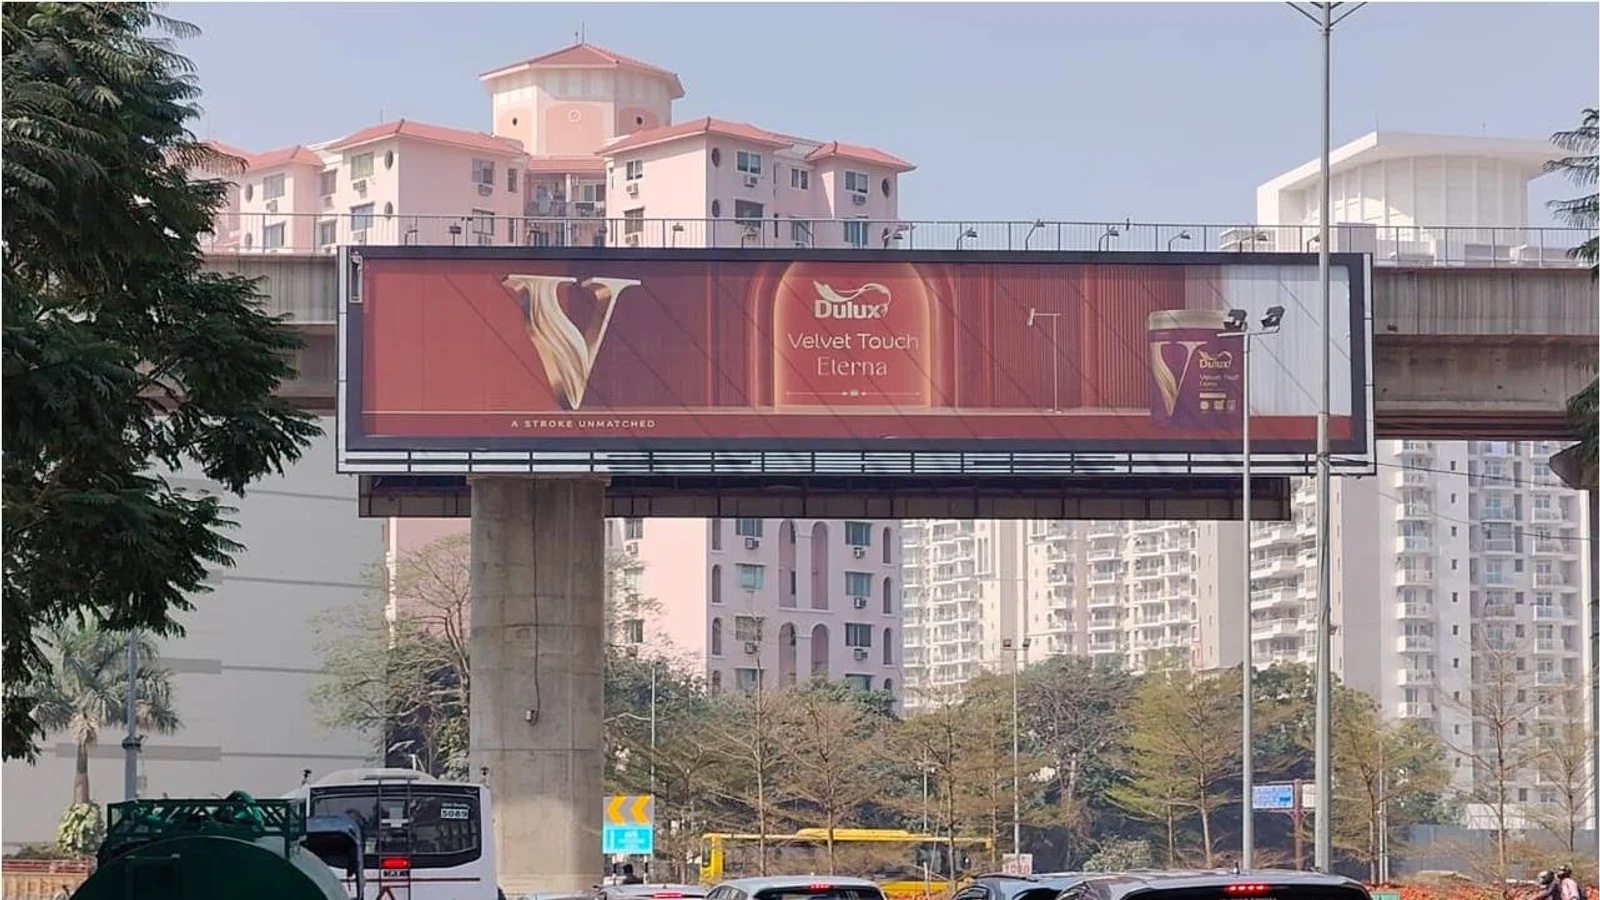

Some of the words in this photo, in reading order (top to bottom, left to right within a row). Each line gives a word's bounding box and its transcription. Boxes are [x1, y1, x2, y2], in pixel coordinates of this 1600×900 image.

[814, 299, 882, 319] Dulux
[502, 274, 642, 411] V
[787, 332, 852, 350] Velvet
[857, 332, 920, 350] Touch
[816, 356, 888, 377] Eterna
[510, 420, 519, 428] A
[524, 420, 573, 428] STROKE
[578, 420, 656, 428] UNMATCHED
